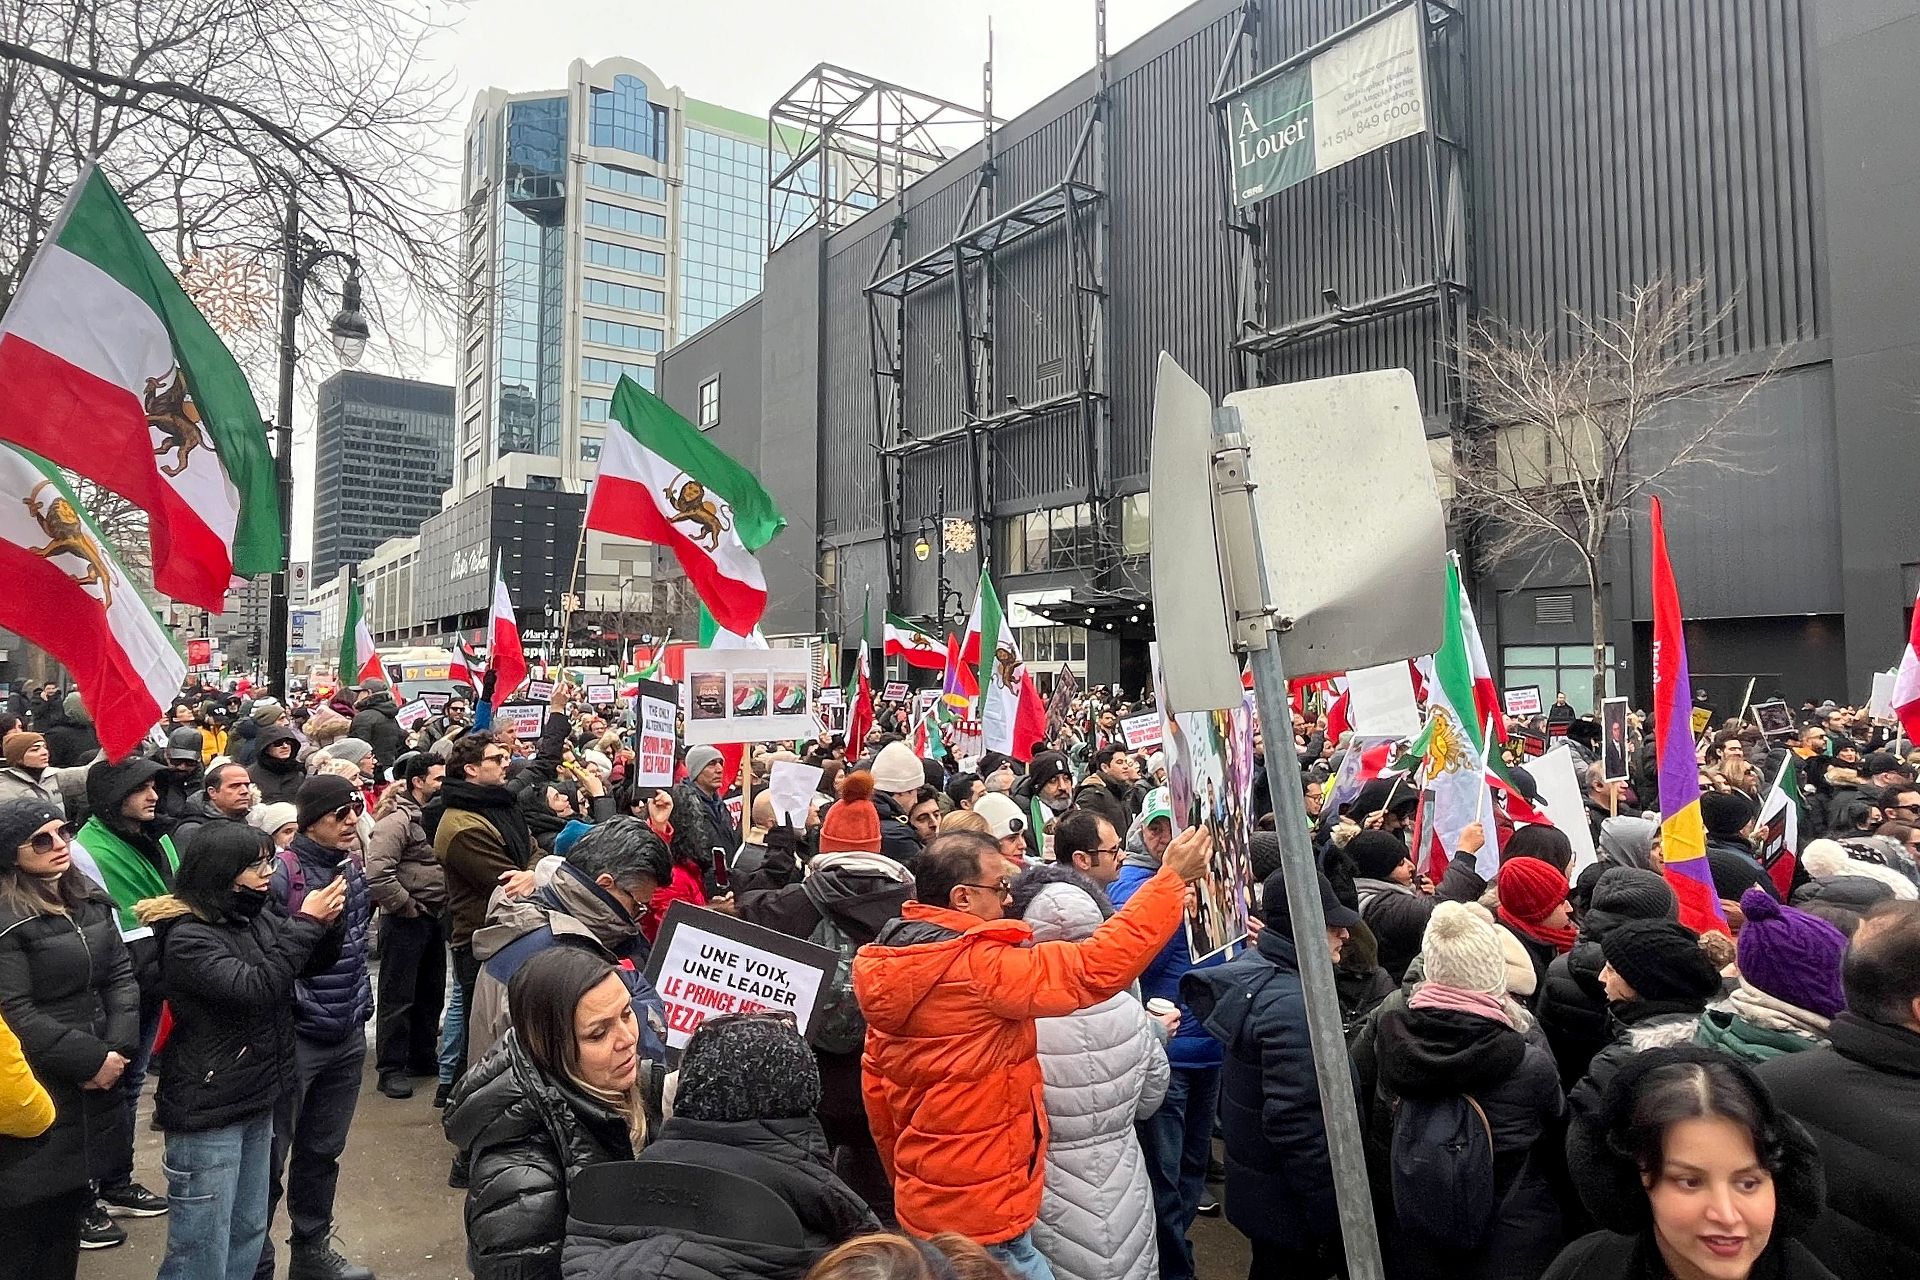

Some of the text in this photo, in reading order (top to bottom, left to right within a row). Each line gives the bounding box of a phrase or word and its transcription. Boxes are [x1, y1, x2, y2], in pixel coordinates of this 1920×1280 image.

[1238, 102, 1260, 139] À
[1321, 135, 1333, 147] +1
[1335, 126, 1354, 144] 514
[1357, 114, 1380, 134] 849
[1384, 99, 1421, 122] 6000
[1239, 117, 1309, 168] Louer
[1241, 184, 1264, 199] CBRE
[649, 704, 670, 719] THE ONLY
[682, 959, 797, 1007] UNE LEADER
[700, 944, 791, 989] UNE VOIX,
[663, 975, 683, 997] LE
[683, 982, 737, 1013] PRINCE
